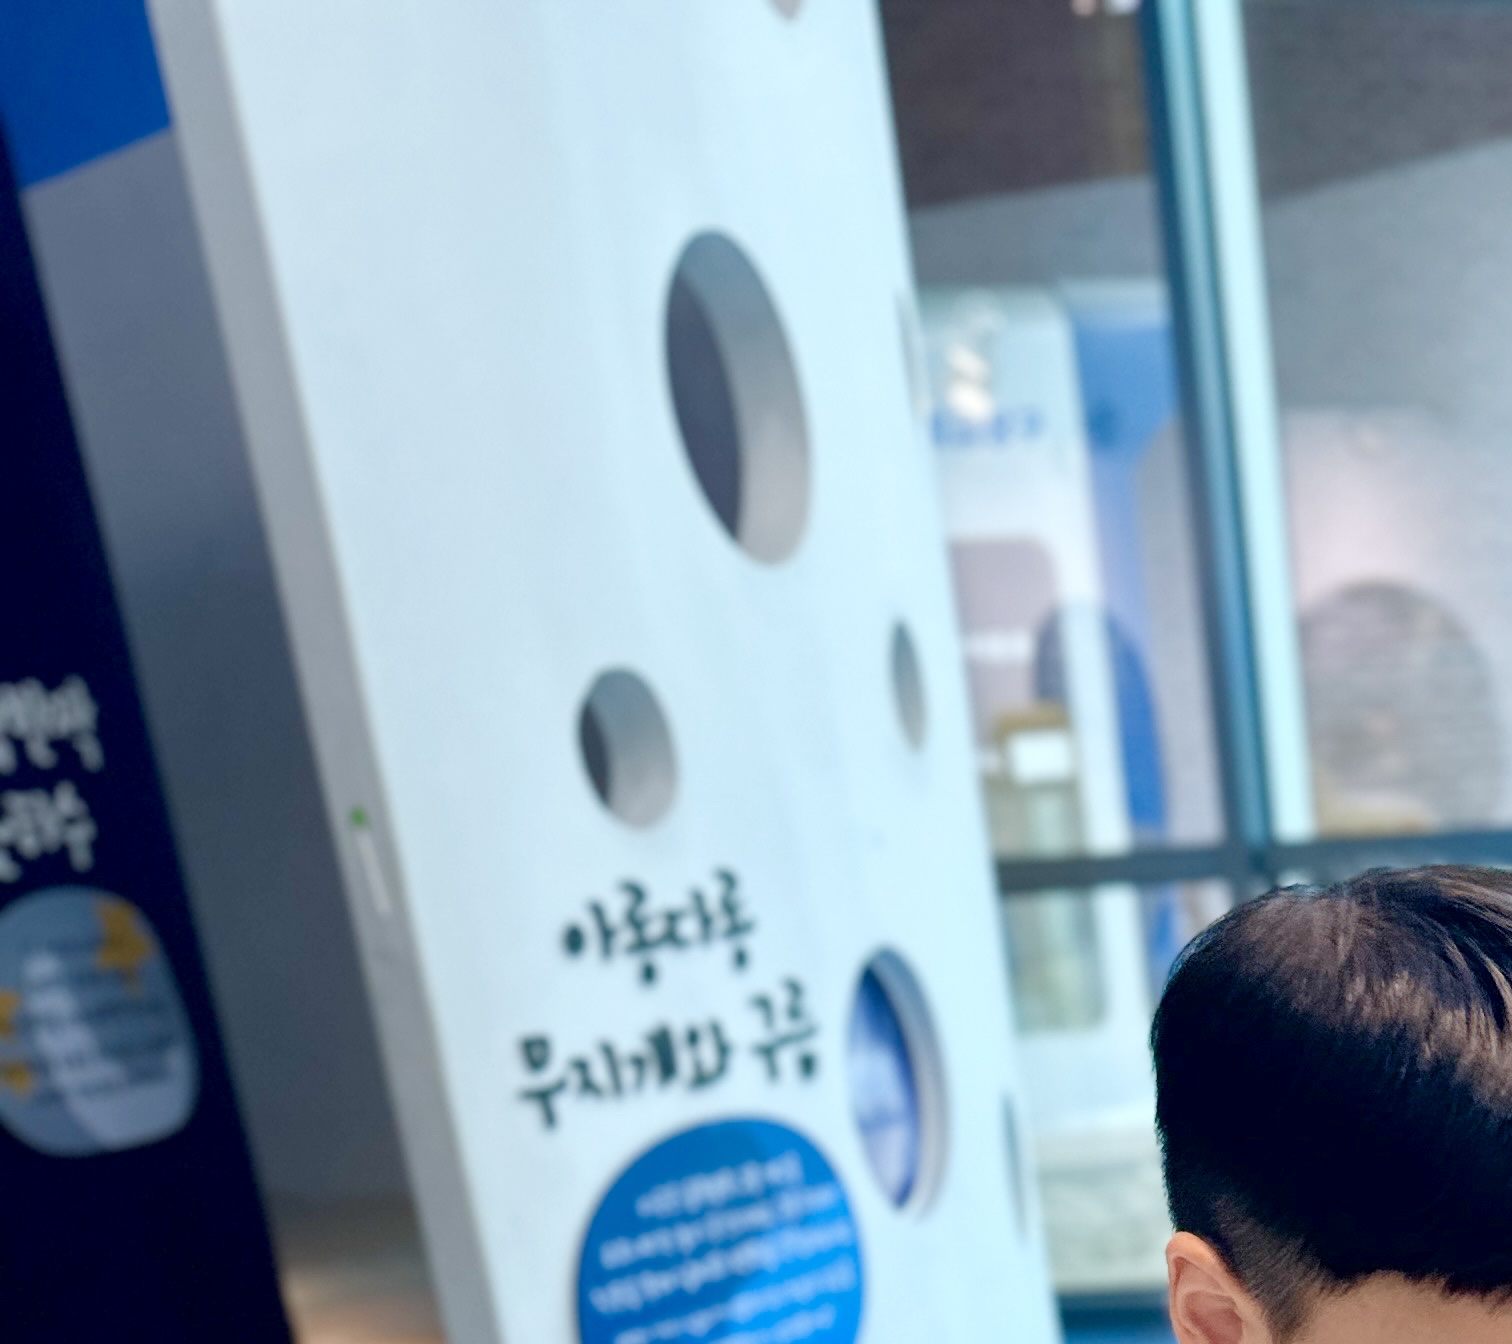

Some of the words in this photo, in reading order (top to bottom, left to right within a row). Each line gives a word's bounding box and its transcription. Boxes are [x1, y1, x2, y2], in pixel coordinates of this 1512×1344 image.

[562, 866, 757, 984] 아롱다롱
[516, 1018, 733, 1130] 무지개와
[751, 975, 818, 1081] 구름
